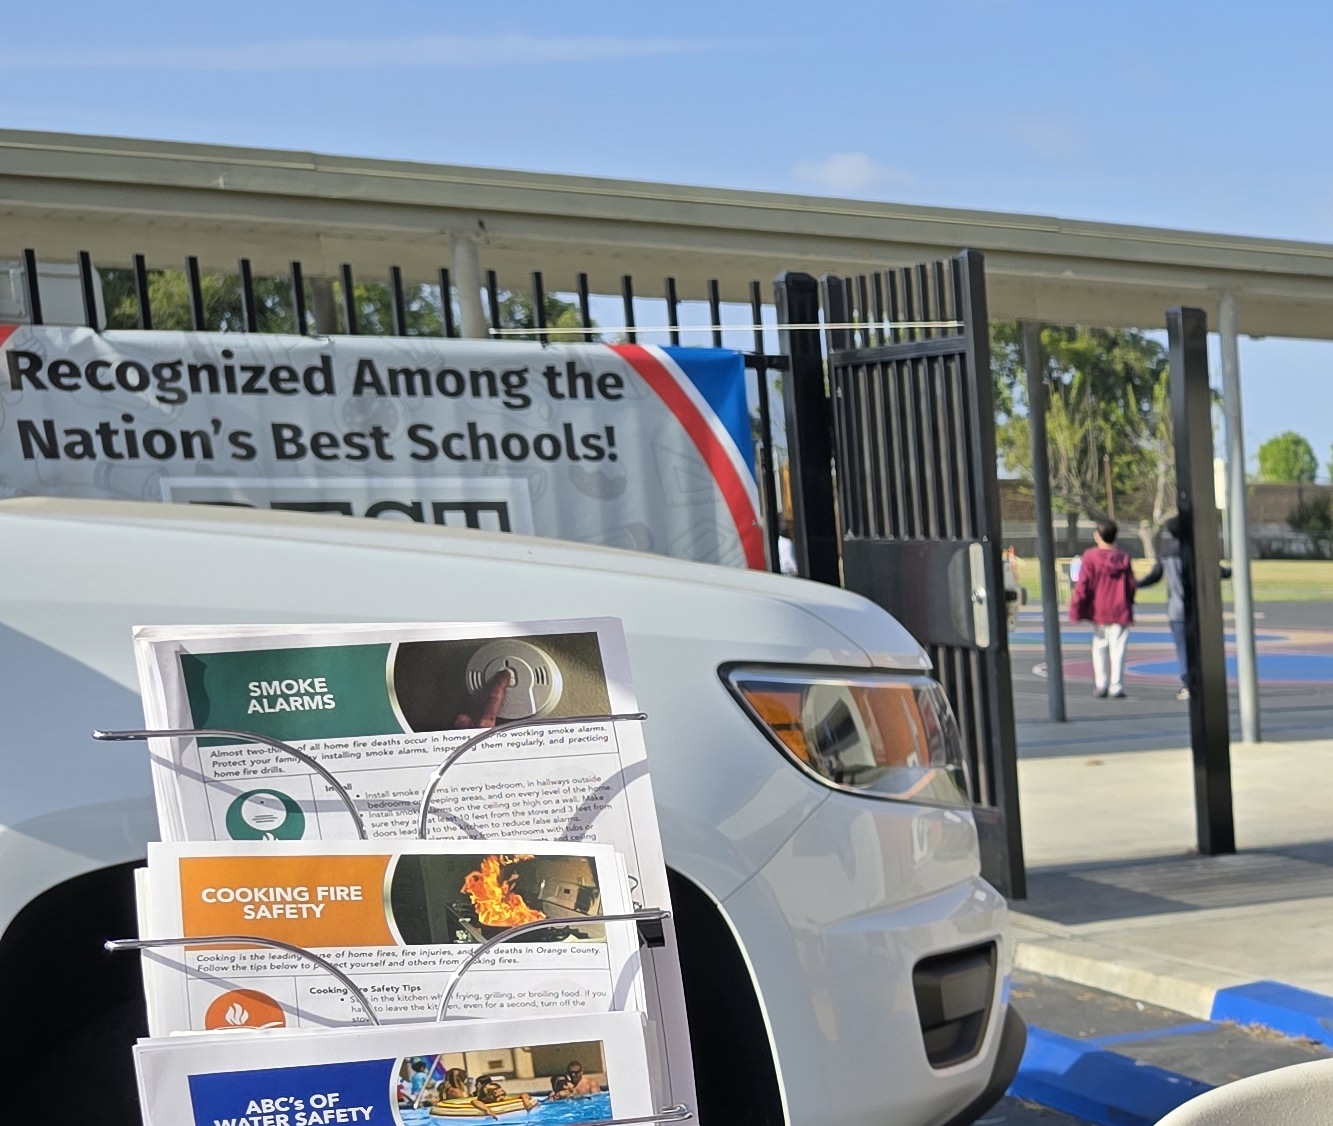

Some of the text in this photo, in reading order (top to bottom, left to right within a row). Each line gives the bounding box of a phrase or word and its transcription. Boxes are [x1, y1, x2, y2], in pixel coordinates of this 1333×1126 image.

[8, 349, 625, 409] Recognized Among the
[17, 412, 618, 462] Nation's Best Schools!
[248, 677, 328, 697] SMOKE
[247, 694, 336, 714] ALARMS
[210, 749, 243, 758] Almost
[324, 742, 350, 750] home
[353, 739, 368, 748] fire
[371, 738, 401, 747] deaths
[510, 729, 544, 738] working
[578, 725, 607, 733] alarms.
[201, 886, 362, 904] COOKING FIRE
[243, 904, 325, 920] SAFETY
[197, 946, 601, 963] Cooking the home fires, fire injuries, deaths Orange County.
[246, 1092, 340, 1115] ABC's OF
